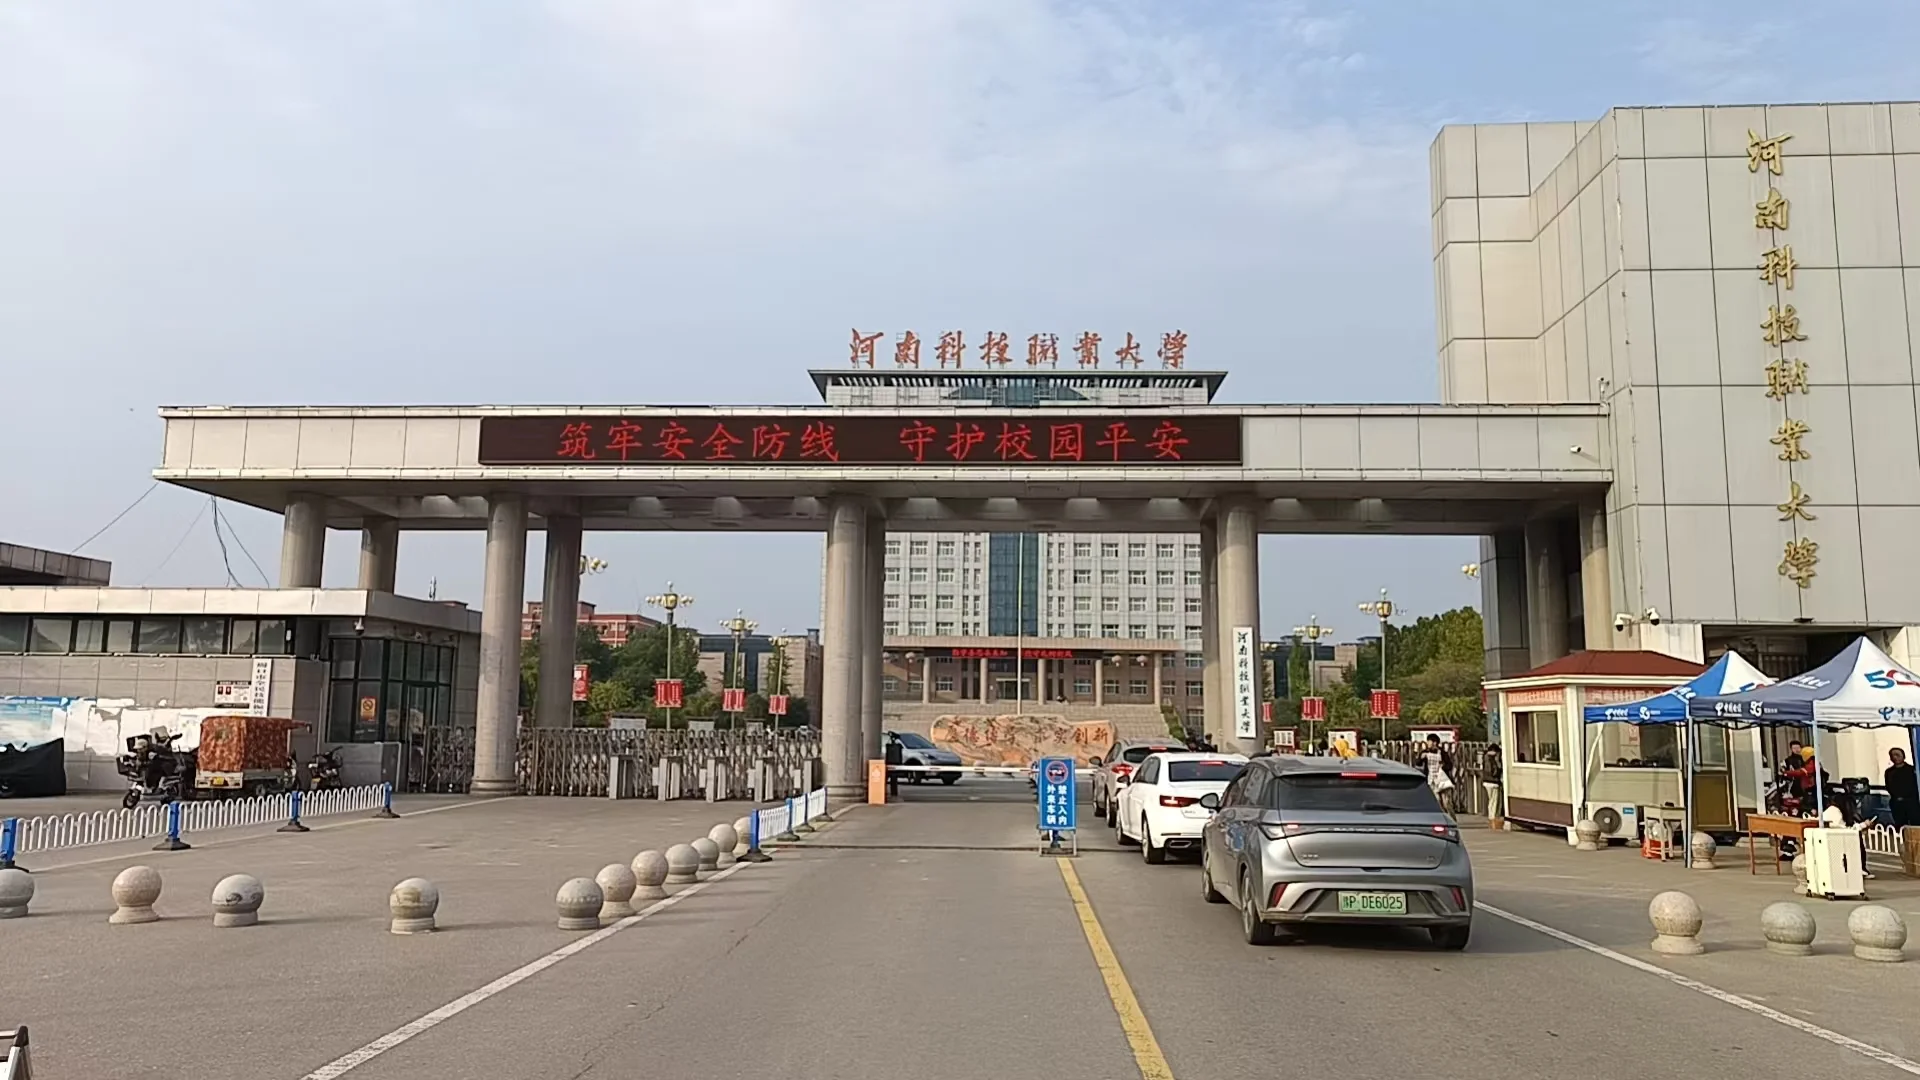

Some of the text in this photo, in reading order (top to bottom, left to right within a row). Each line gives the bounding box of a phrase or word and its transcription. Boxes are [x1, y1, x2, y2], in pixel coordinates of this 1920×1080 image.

[557, 420, 1189, 462] 筑牢安全防线 守护校园平安
[1749, 700, 1764, 717] 5G
[1046, 784, 1056, 825] 外来车辆
[1058, 784, 1068, 826] 禁止入内
